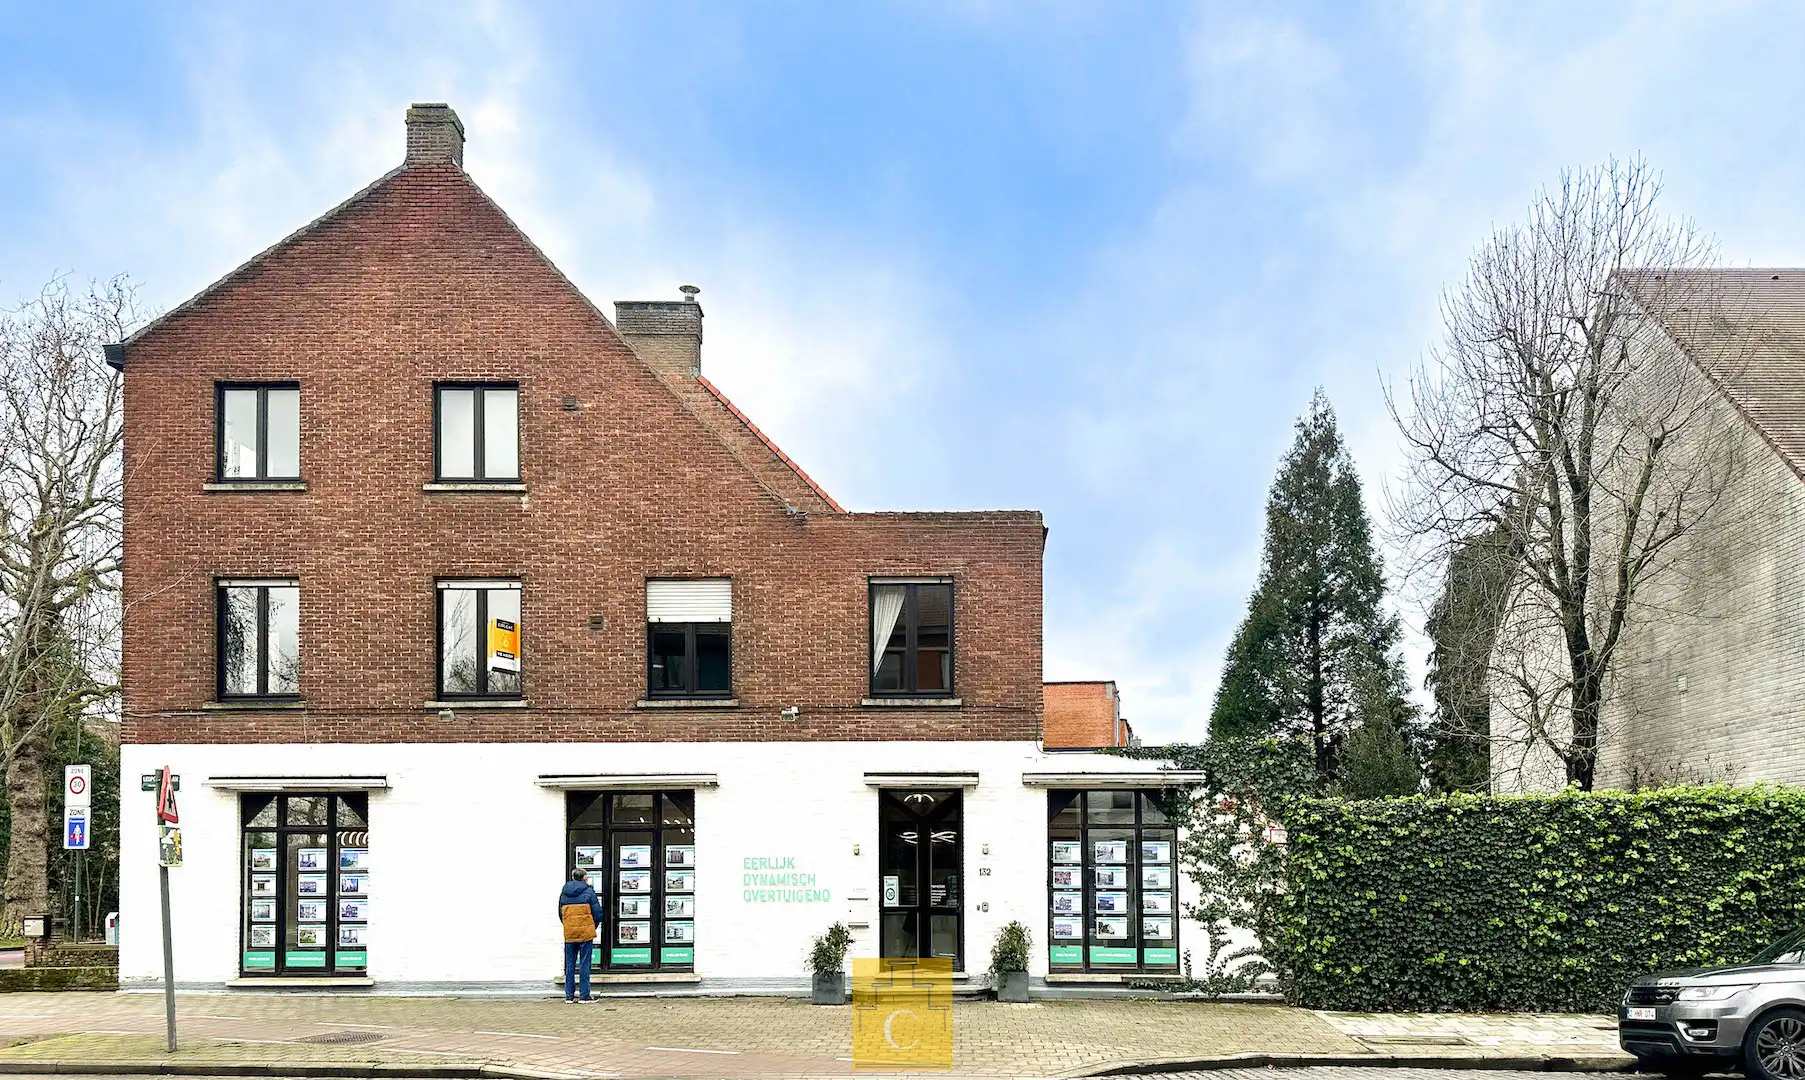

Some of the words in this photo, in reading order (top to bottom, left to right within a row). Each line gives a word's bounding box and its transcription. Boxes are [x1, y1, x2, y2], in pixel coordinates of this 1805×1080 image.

[743, 857, 795, 870] EERLIJK
[979, 867, 992, 877] 132
[743, 873, 816, 887] DYNAMISCH
[743, 889, 831, 903] OVERTUIGEND
